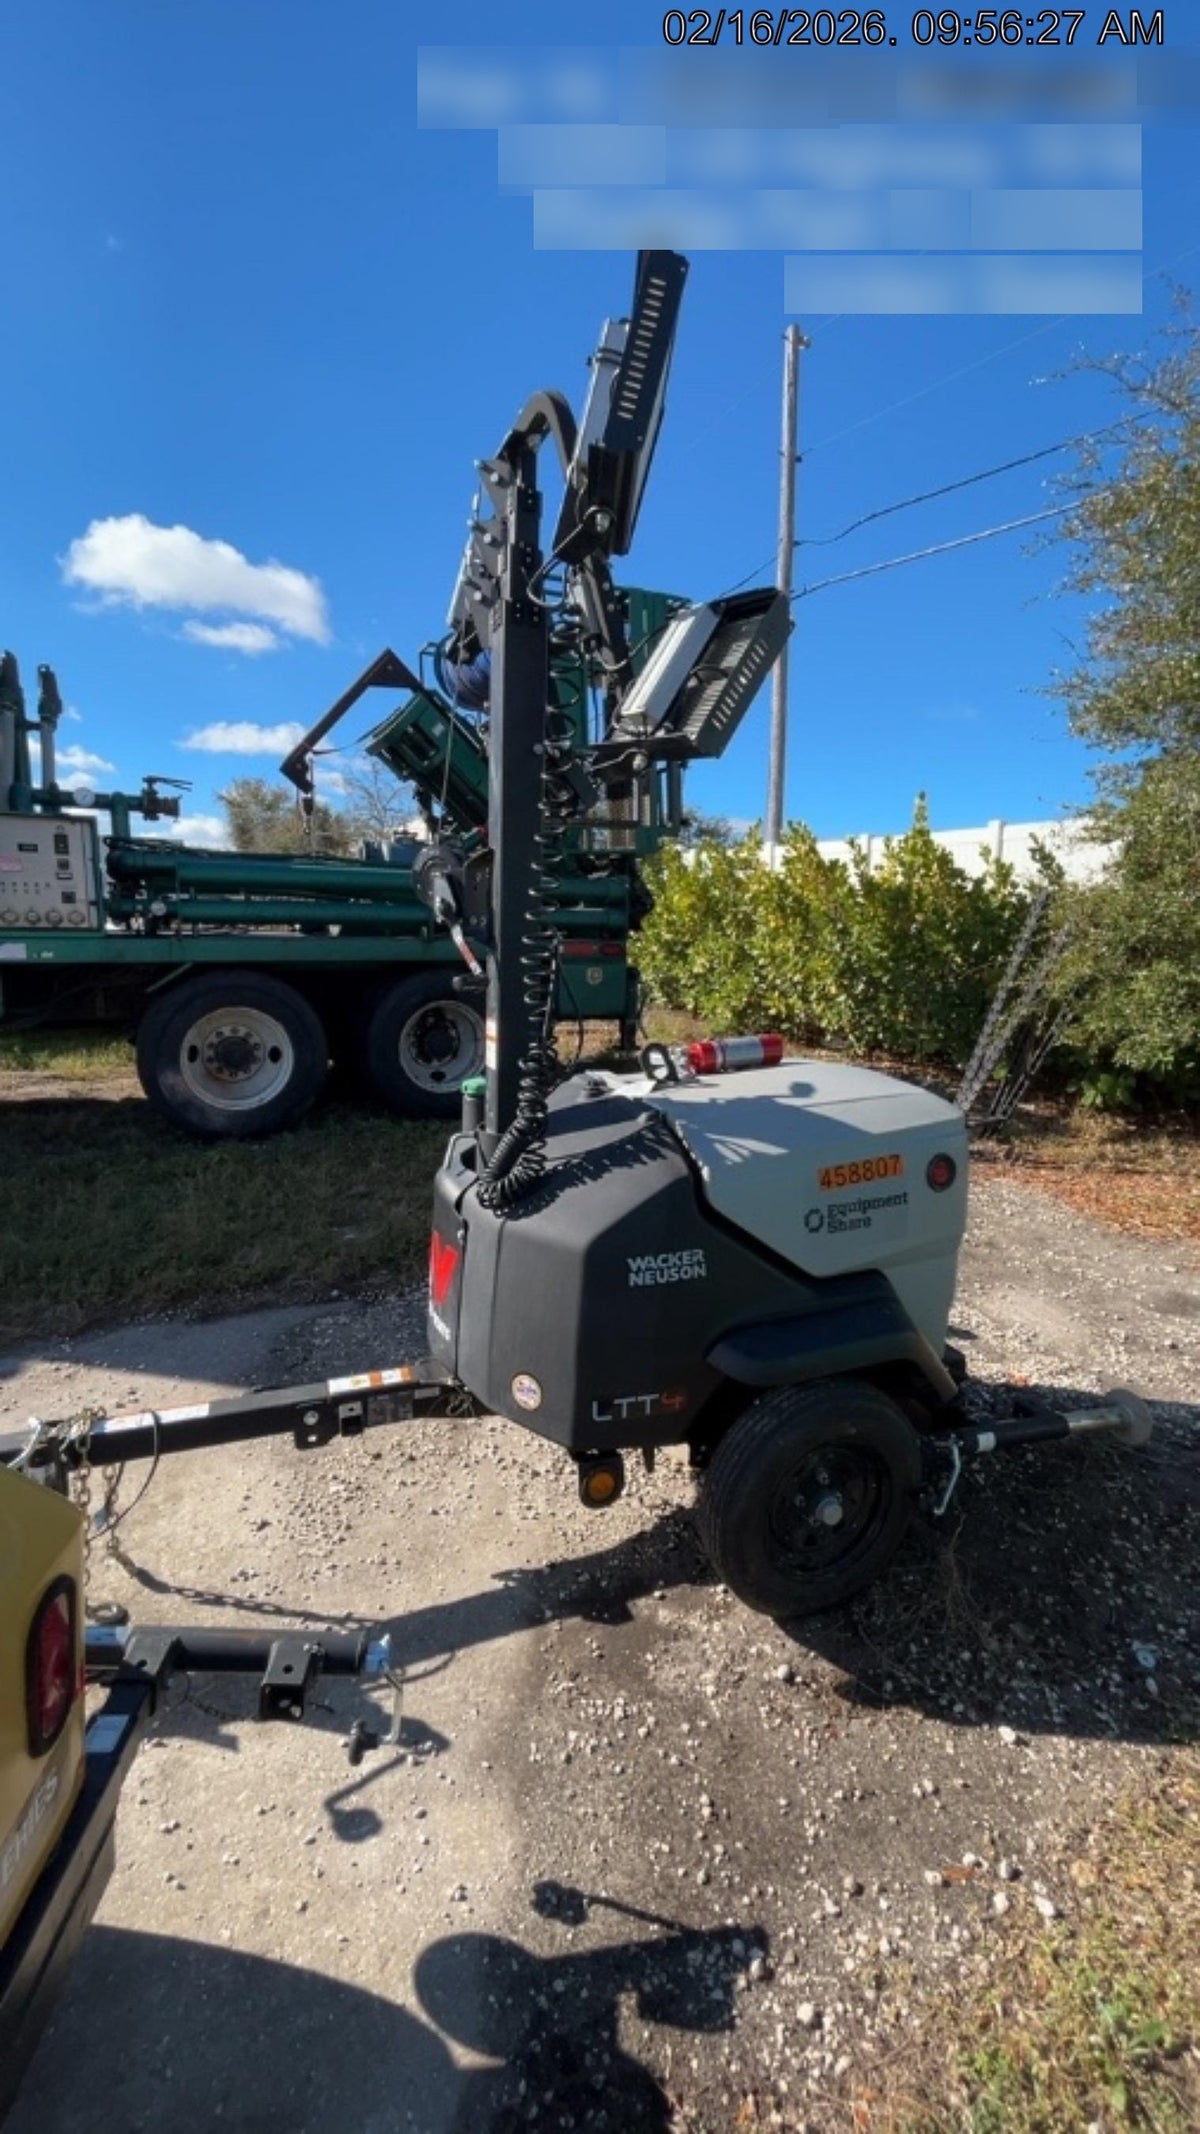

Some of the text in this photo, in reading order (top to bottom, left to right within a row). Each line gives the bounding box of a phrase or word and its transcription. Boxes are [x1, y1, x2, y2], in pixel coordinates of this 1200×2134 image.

[820, 1153, 901, 1189] 458807
[827, 1192, 908, 1219] Equipment
[827, 1216, 873, 1234] Share
[626, 1249, 705, 1272] WACKER
[628, 1263, 708, 1287] NEUSON
